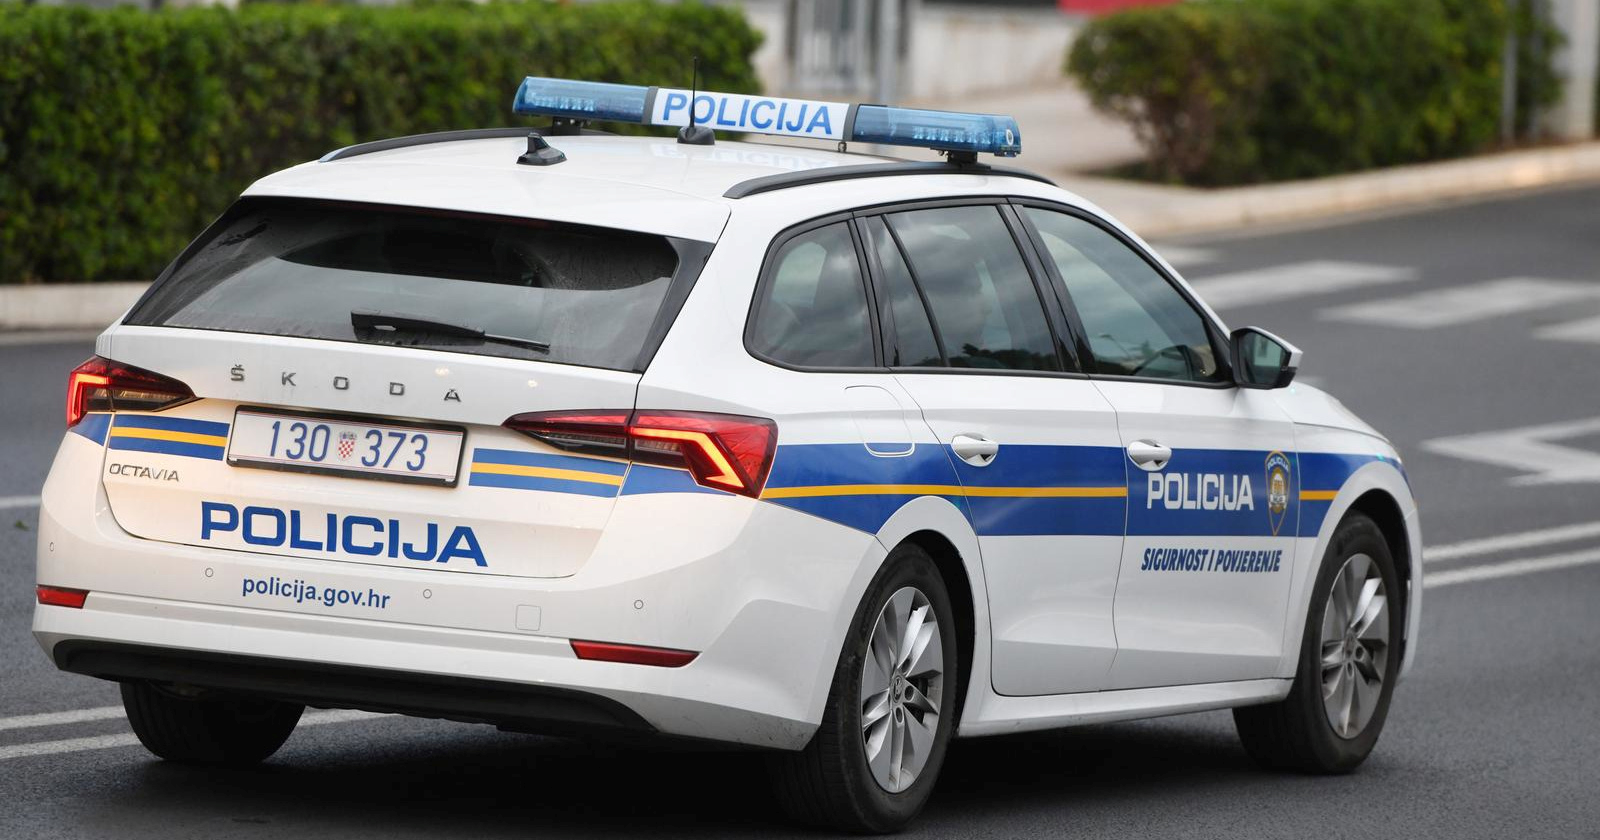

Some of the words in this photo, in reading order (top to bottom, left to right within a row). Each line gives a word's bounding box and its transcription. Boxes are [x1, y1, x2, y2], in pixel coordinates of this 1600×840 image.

[662, 93, 832, 134] POLICIJA
[270, 420, 330, 463] 130
[361, 429, 429, 472] 373
[109, 463, 180, 483] OCTAVIA
[1147, 472, 1254, 511] POLICIJA
[200, 501, 489, 568] POLICIJA
[1141, 548, 1208, 571] SIGURNOST
[1208, 550, 1215, 571] I
[1216, 550, 1282, 572] POVJERENJE
[242, 577, 390, 608] policija.gov.hr
